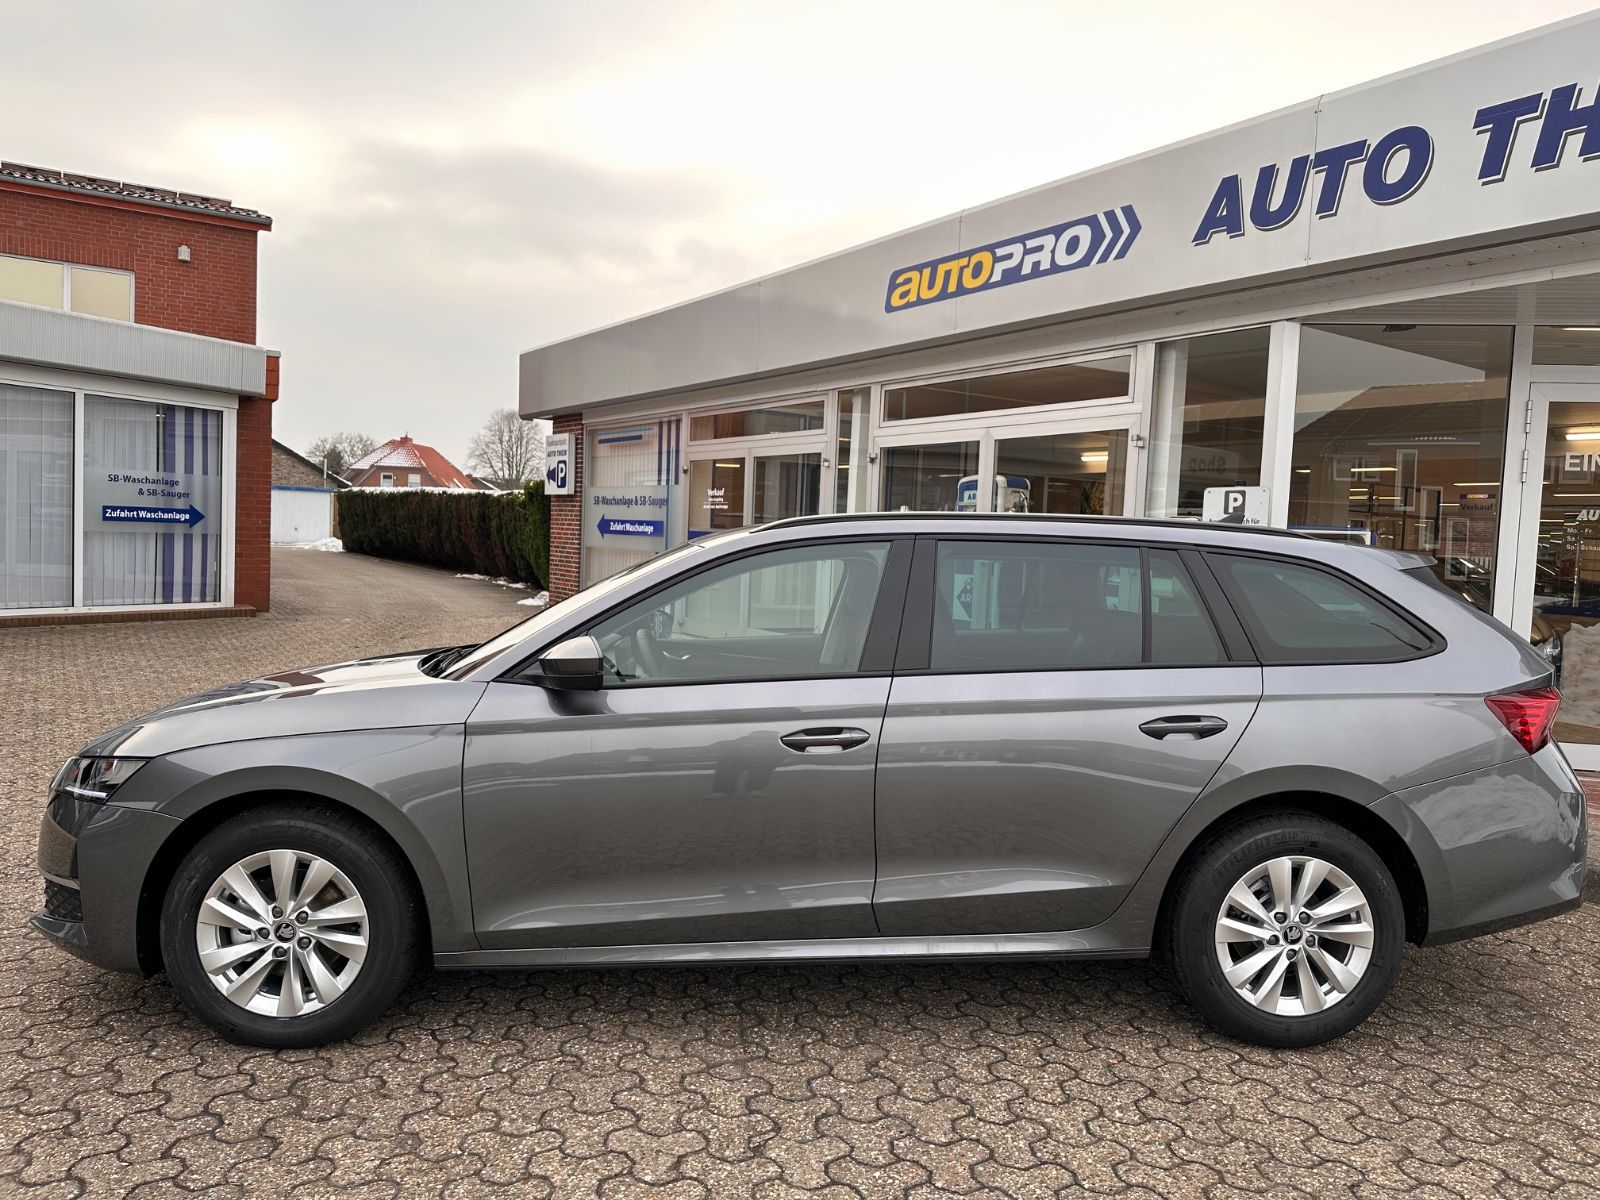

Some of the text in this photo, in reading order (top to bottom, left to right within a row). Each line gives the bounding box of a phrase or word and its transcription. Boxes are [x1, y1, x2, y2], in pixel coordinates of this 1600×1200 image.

[1191, 81, 1600, 247] AUTO TH
[107, 474, 180, 488] SB-Waschanlage
[558, 462, 566, 486] P
[137, 488, 191, 500] & SB-Sauger
[593, 495, 634, 508] SB-Waschanlage
[634, 495, 639, 506] &
[1227, 492, 1243, 513] P
[105, 509, 190, 521] Zufahrt Waschanlage
[609, 521, 654, 535] Zufahrt Waschanlage
